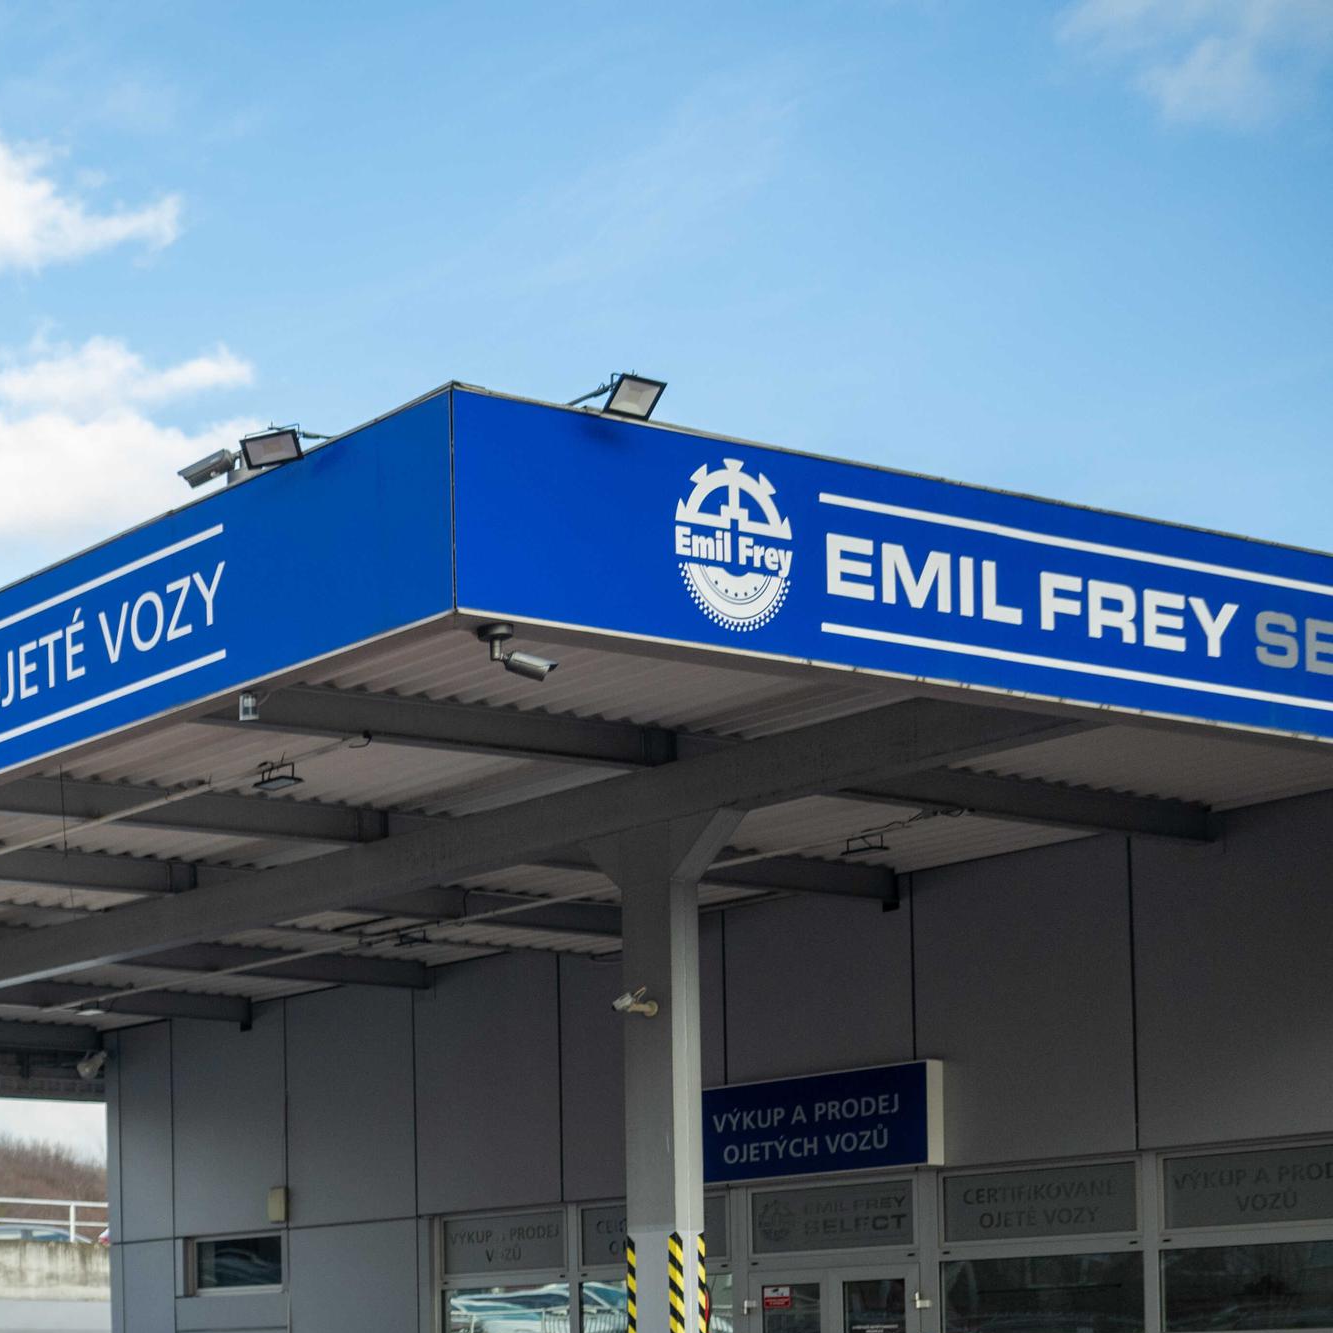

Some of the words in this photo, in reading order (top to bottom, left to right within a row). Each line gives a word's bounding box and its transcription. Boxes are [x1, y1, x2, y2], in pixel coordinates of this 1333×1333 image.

[675, 525, 732, 563] Emil
[738, 536, 793, 578] Frey
[98, 560, 226, 665] VOZY
[826, 532, 1023, 625] EMIL
[1040, 571, 1239, 658] FREY
[712, 1106, 786, 1133] VÝKUP
[791, 1104, 807, 1125] A
[814, 1092, 900, 1122] PRODEJ
[723, 1134, 819, 1165] OJETÝCH
[825, 1122, 889, 1153] VOZŮ
